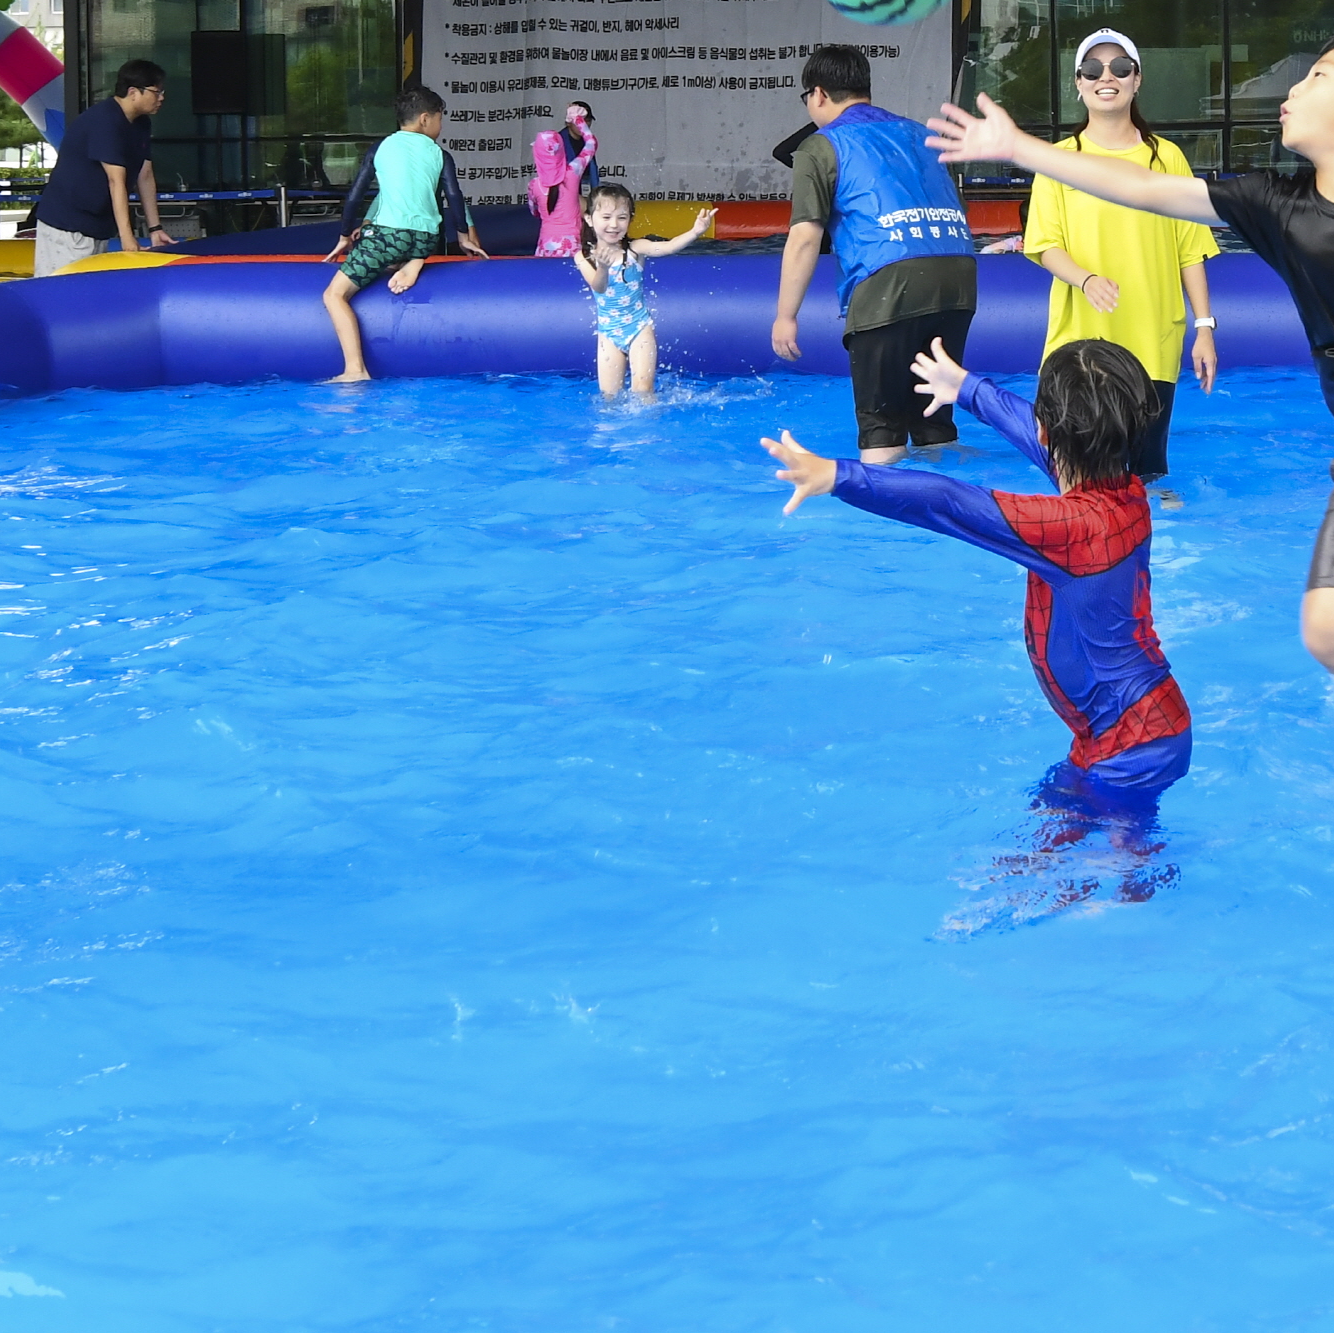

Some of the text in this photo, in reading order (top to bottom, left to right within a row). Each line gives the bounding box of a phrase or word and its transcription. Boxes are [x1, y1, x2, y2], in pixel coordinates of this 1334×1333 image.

[452, 23, 487, 37] 착용금지
[494, 20, 518, 35] 상해를
[537, 18, 547, 31] 수
[549, 18, 567, 31] 있는
[625, 19, 643, 32] 헤어
[645, 17, 679, 31] 악세사리
[451, 52, 487, 65] 수질관리
[489, 51, 498, 64] 및
[499, 49, 524, 64] 환경을
[525, 47, 550, 61] 위하여
[552, 47, 588, 62] 물놀이장
[590, 48, 618, 62] 내에서
[620, 48, 638, 62] 음료
[640, 48, 649, 61] 및
[651, 46, 695, 60] 아이스크림
[698, 46, 708, 60] 등
[709, 47, 747, 60] 음식물의
[748, 48, 776, 61] 섭취는
[778, 46, 796, 59] 불가
[451, 80, 478, 94] 물놀이
[480, 80, 505, 93] 이용시
[661, 75, 679, 88] 세로
[719, 77, 746, 90] 사용이
[450, 109, 486, 123] 쓰레기는
[449, 138, 512, 152] 애완견 출입금지
[468, 166, 519, 180] 공기주입기는
